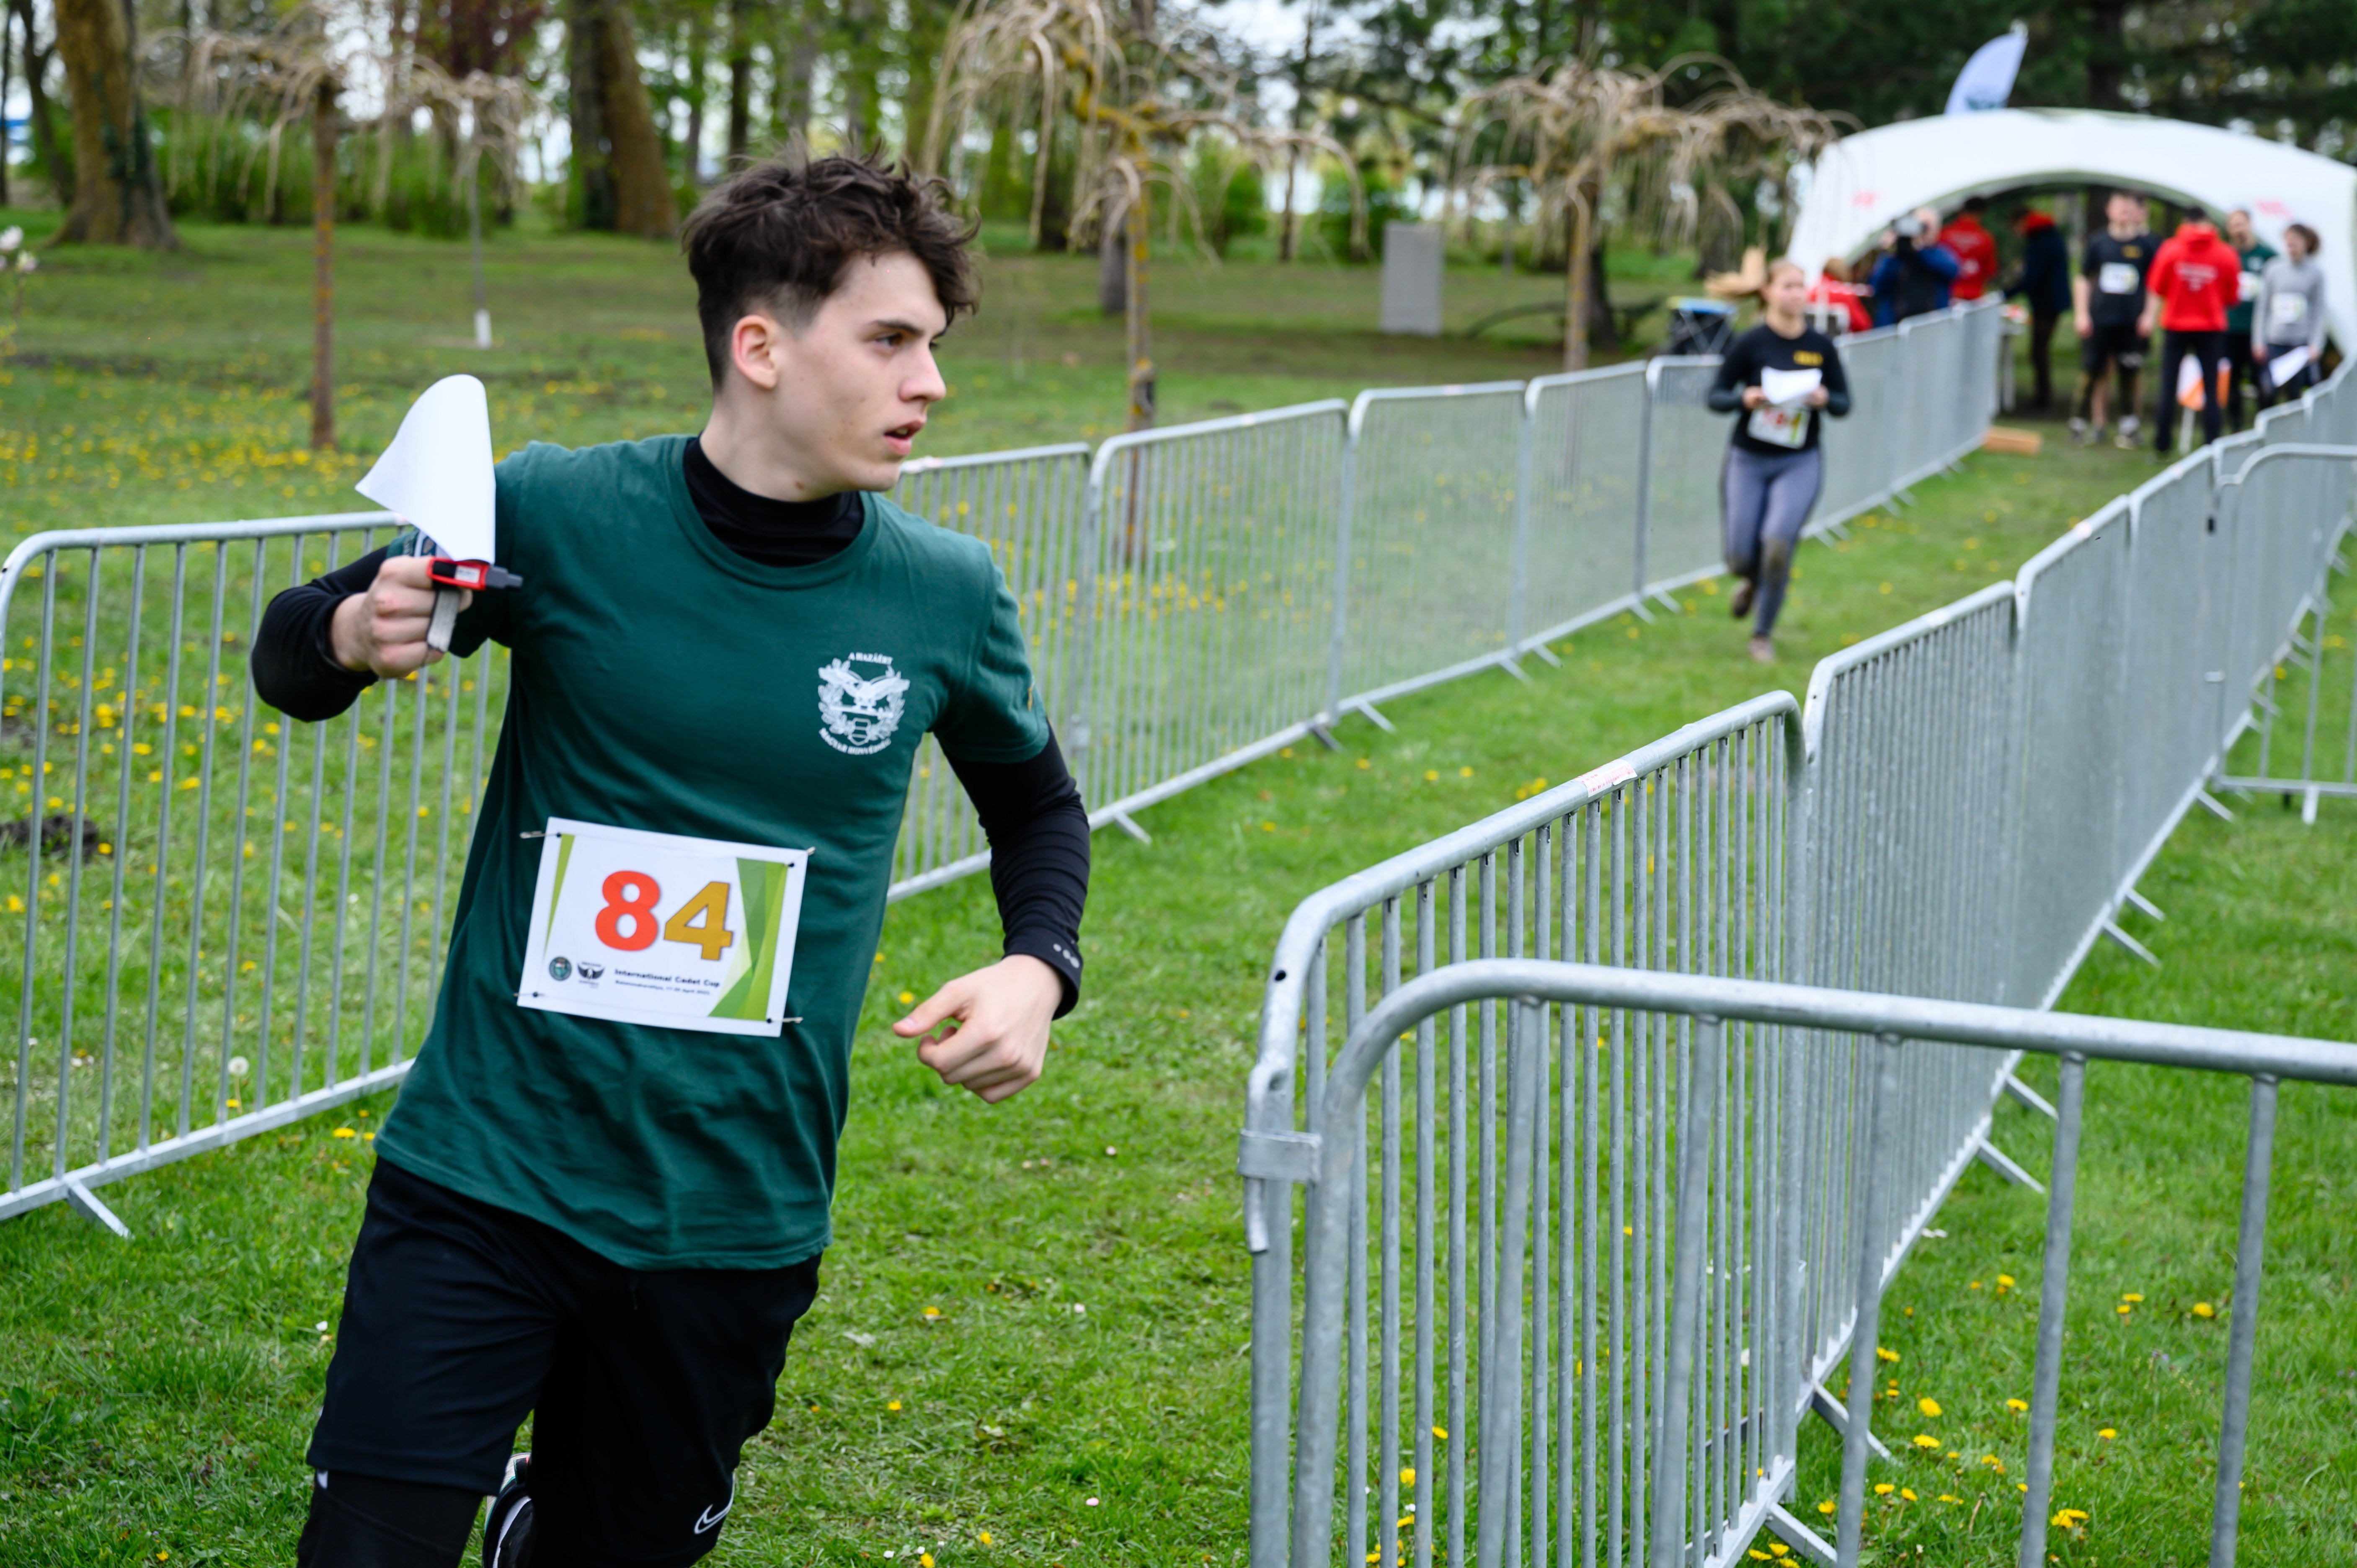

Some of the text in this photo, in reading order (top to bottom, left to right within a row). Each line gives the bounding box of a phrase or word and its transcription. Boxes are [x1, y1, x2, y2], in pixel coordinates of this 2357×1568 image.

[595, 870, 733, 961] 84
[614, 968, 672, 982] International
[674, 976, 701, 985] Cadet
[703, 979, 721, 988] Cup
